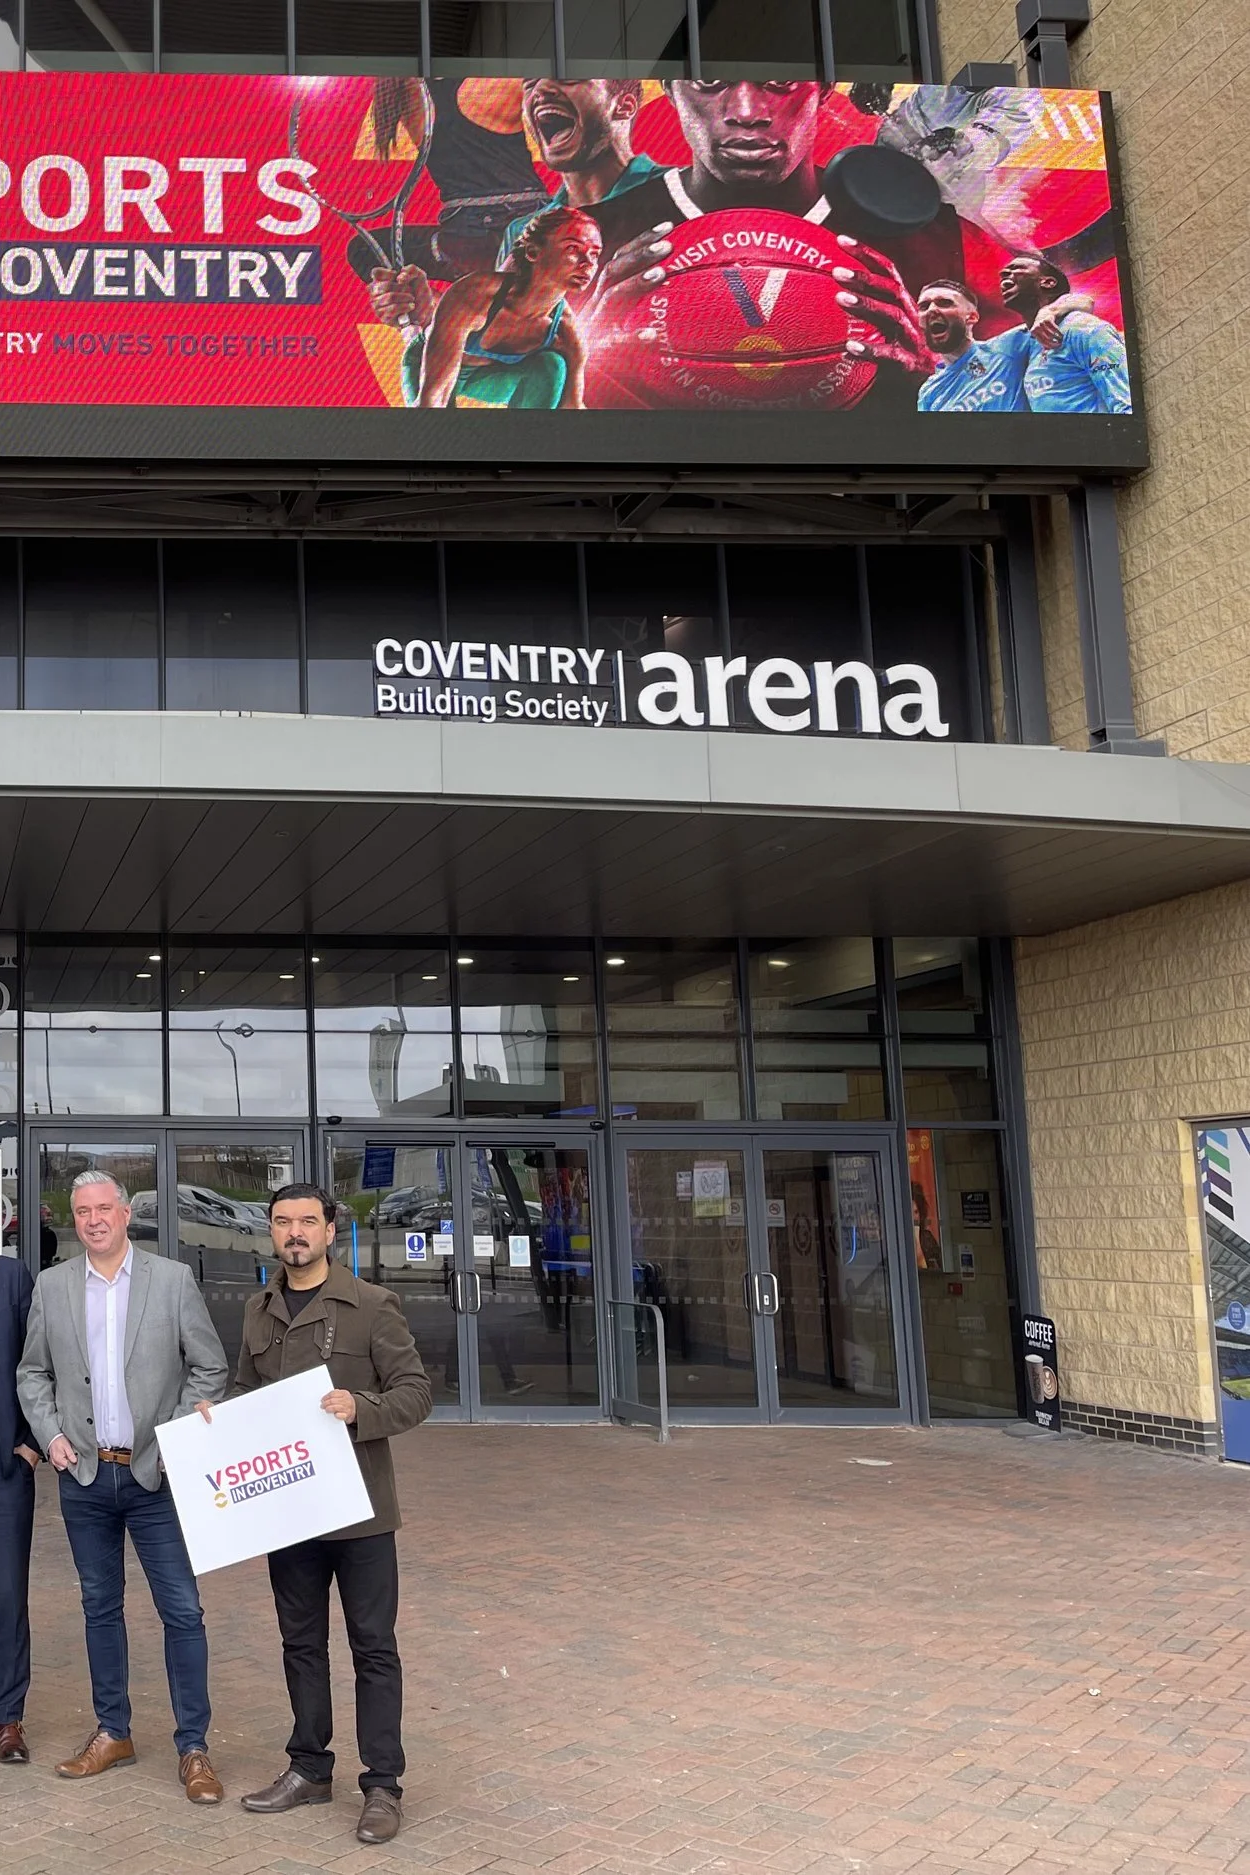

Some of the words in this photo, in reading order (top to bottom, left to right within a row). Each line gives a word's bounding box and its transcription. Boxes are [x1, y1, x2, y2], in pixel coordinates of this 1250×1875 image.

[668, 237, 717, 272] VISIT
[722, 231, 833, 269] COVENTRY
[53, 333, 152, 357] MOVES
[160, 335, 320, 358] TOGETHER
[375, 638, 606, 686] COVENTRY
[376, 685, 497, 724] Building
[504, 690, 609, 727] Society
[637, 650, 950, 737] arena
[1024, 1320, 1053, 1343] COFFEE
[224, 1440, 311, 1486] SPORTS
[231, 1487, 247, 1502] IN
[246, 1462, 312, 1497] COVENTRY
